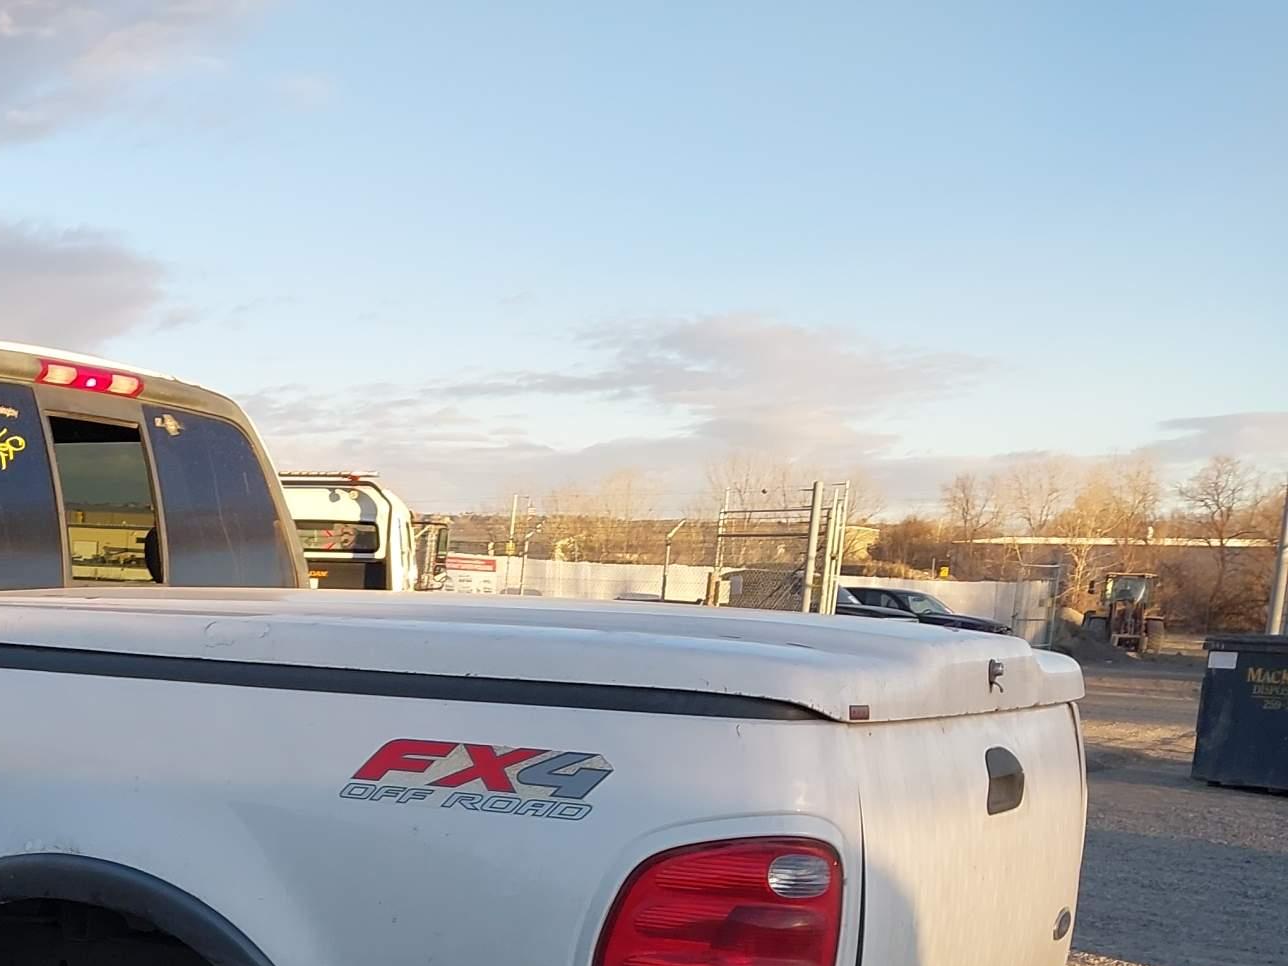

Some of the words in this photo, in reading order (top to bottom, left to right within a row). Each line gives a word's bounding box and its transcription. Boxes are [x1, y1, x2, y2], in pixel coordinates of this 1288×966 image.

[351, 738, 614, 800] FX4
[339, 782, 434, 804] OFF
[441, 791, 593, 821] ROAD
